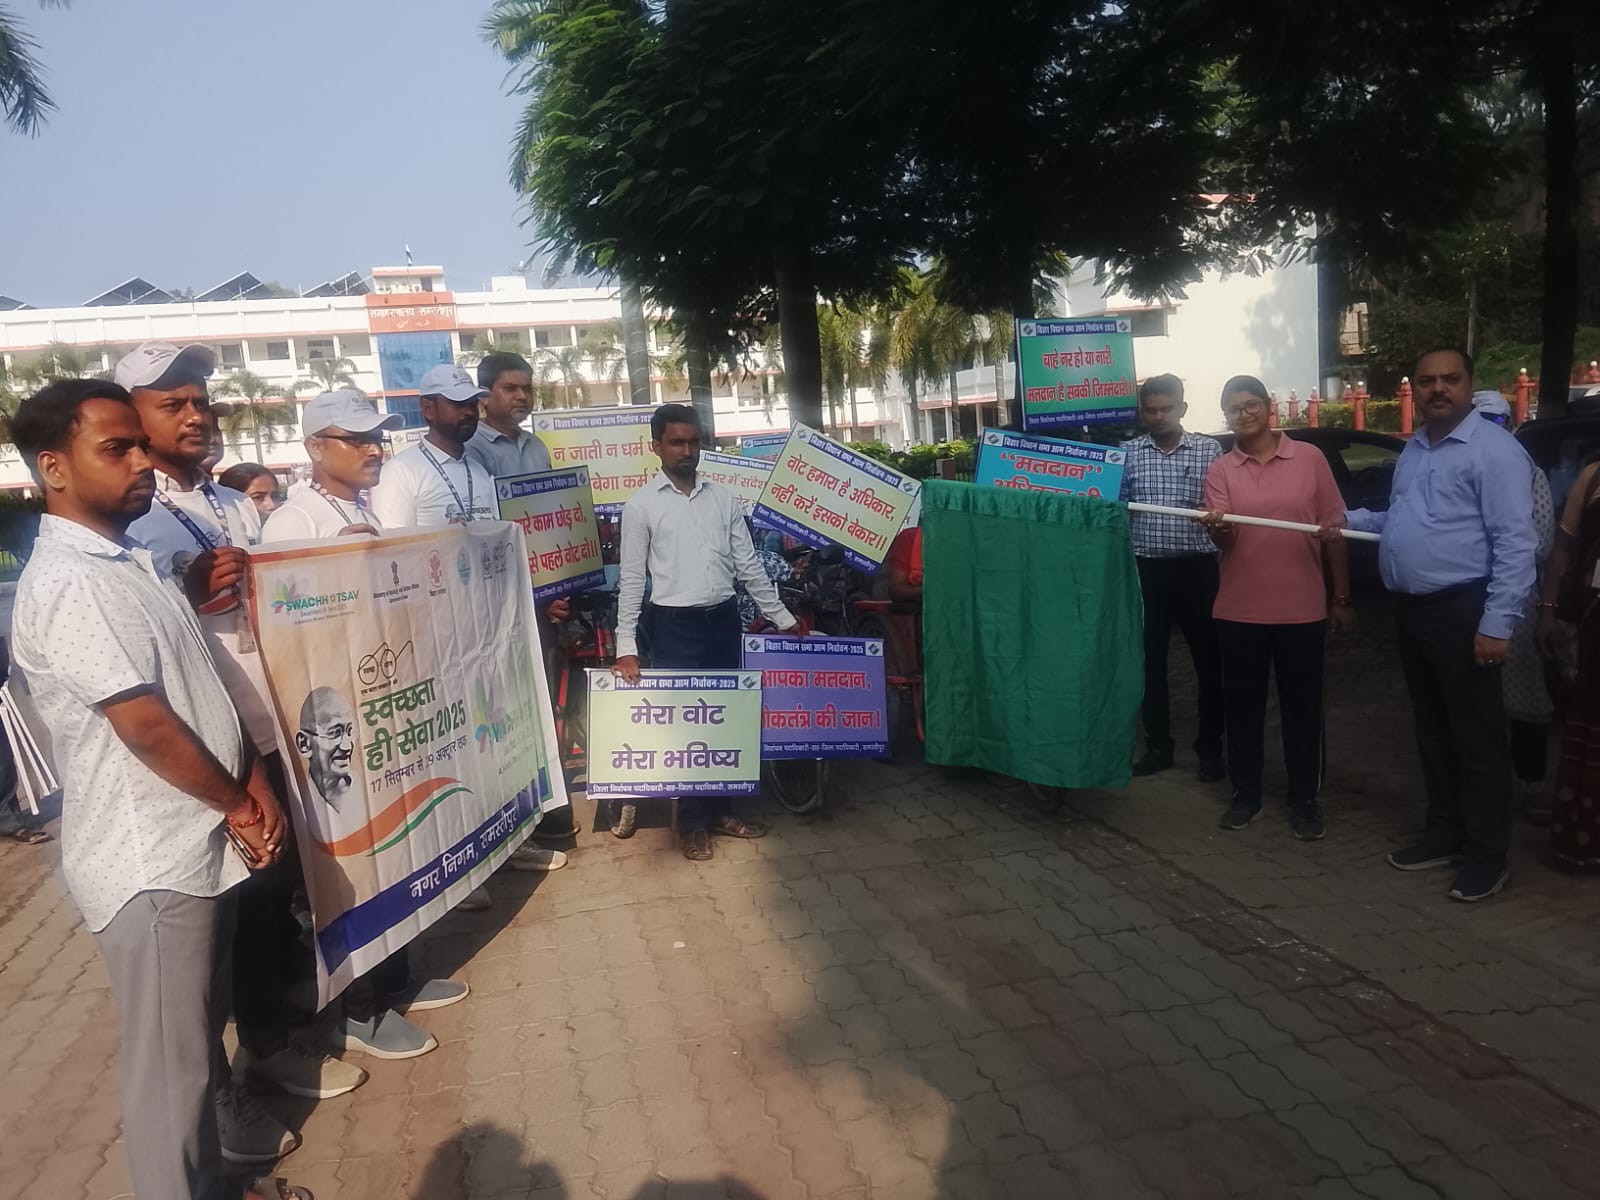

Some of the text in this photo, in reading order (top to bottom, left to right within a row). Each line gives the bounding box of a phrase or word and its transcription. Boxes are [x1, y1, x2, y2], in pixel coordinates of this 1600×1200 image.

[1042, 348, 1059, 369] चाहे
[1060, 351, 1073, 367] नर
[1073, 346, 1083, 368] हो
[1085, 351, 1094, 366] या
[1027, 386, 1056, 403] मतदान
[1057, 380, 1065, 402] है
[617, 414, 654, 425] निर्वाचन-202
[553, 447, 566, 461] न
[568, 439, 602, 461] जाती
[605, 444, 618, 458] न
[621, 436, 644, 457] धर्म
[591, 472, 619, 492] बेगा
[622, 468, 649, 489] कर्म
[785, 454, 809, 476] वोट
[806, 466, 840, 492] हमारा
[838, 477, 852, 498] है
[850, 488, 896, 522] अधिकार,
[533, 511, 555, 532] काम
[555, 504, 572, 531] छोड़
[771, 482, 798, 505] नहीं
[793, 494, 818, 515] करें
[812, 504, 848, 532] इसको
[540, 544, 563, 571] पहले
[564, 540, 581, 565] वोट
[813, 671, 872, 691] मतदान,
[360, 677, 436, 726] स्वच्छता
[630, 697, 727, 726] मेरा वोट
[762, 703, 880, 729] ोकतंत्र की जान।
[363, 727, 393, 771] ही
[396, 718, 434, 755] सेवा
[436, 699, 466, 738] 2025
[370, 778, 382, 793] 17
[384, 763, 416, 788] सितम्बर
[416, 755, 425, 771] से
[436, 741, 457, 761] अक्टूर
[611, 741, 742, 770] मेरा भविष्य
[410, 806, 519, 898] नगर निगम, समस्तीपुर
